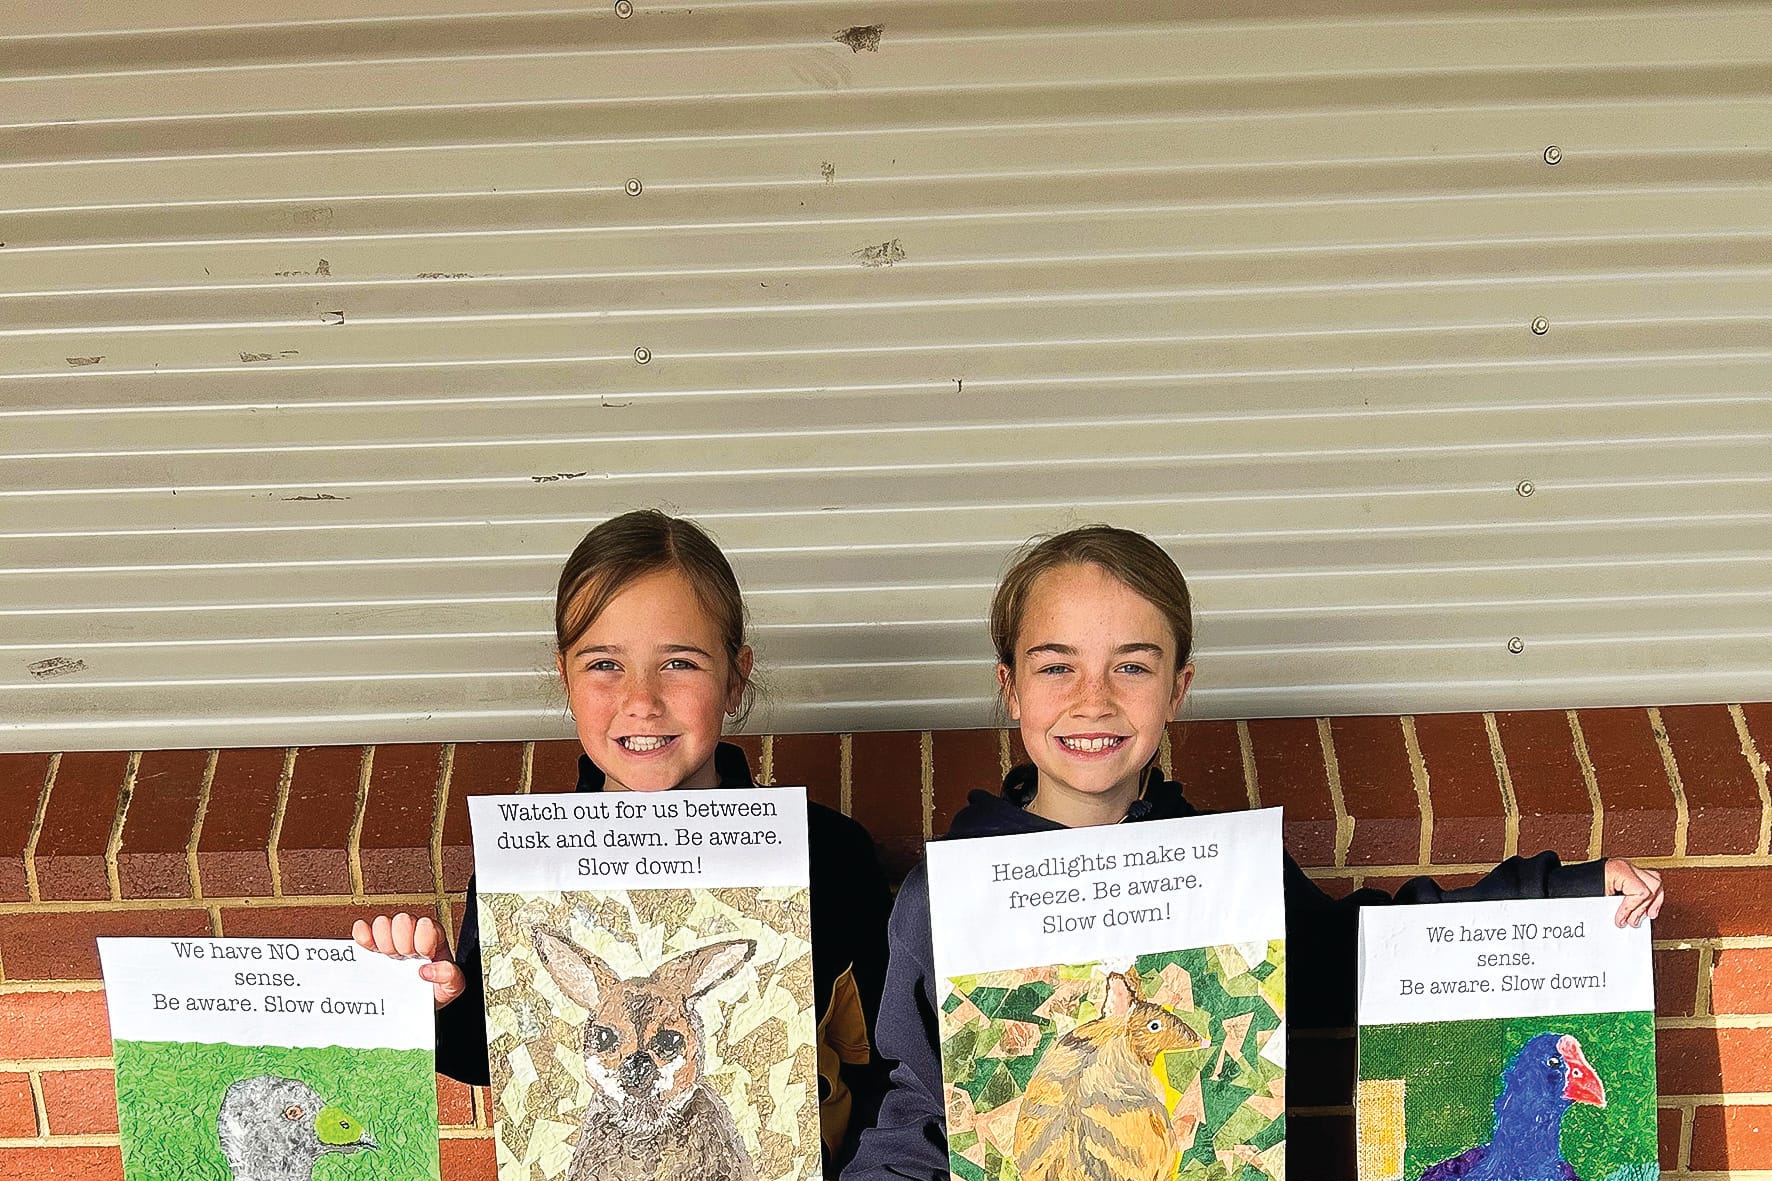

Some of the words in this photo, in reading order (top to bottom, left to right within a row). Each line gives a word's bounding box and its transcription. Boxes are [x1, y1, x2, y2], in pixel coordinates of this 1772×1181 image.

[496, 802, 569, 822] Watch
[573, 801, 610, 820] out
[614, 800, 648, 819] for
[654, 803, 679, 819] us
[682, 799, 778, 818] between
[497, 830, 552, 850] dusk
[556, 829, 598, 849] and
[603, 829, 669, 848] dawn.
[673, 828, 703, 847] Be
[709, 830, 783, 846] aware.
[577, 857, 630, 876] Slow
[635, 855, 702, 876] down!
[991, 852, 1117, 883] Headlights
[1122, 845, 1186, 868] make
[1191, 843, 1219, 860] us
[1008, 888, 1086, 910] freeze.
[1091, 881, 1121, 901] Be
[1127, 874, 1203, 896] aware.
[1042, 914, 1097, 935] Slow
[1102, 901, 1171, 928] down!
[1425, 926, 1455, 944] We
[1458, 925, 1507, 943] have
[1511, 923, 1538, 941] NO
[1541, 921, 1586, 940] road
[170, 941, 205, 959] We
[208, 942, 263, 960] have
[266, 943, 300, 961] NO
[304, 945, 357, 962] road
[1477, 952, 1535, 968] sense.
[234, 972, 301, 987] sense.
[1399, 979, 1425, 996] Be
[1429, 979, 1495, 995] aware.
[1501, 974, 1546, 993] Slow
[1550, 970, 1607, 990] down!
[151, 993, 180, 1011] Be
[185, 997, 258, 1012] aware.
[264, 995, 316, 1014] Slow
[320, 996, 385, 1016] down!
